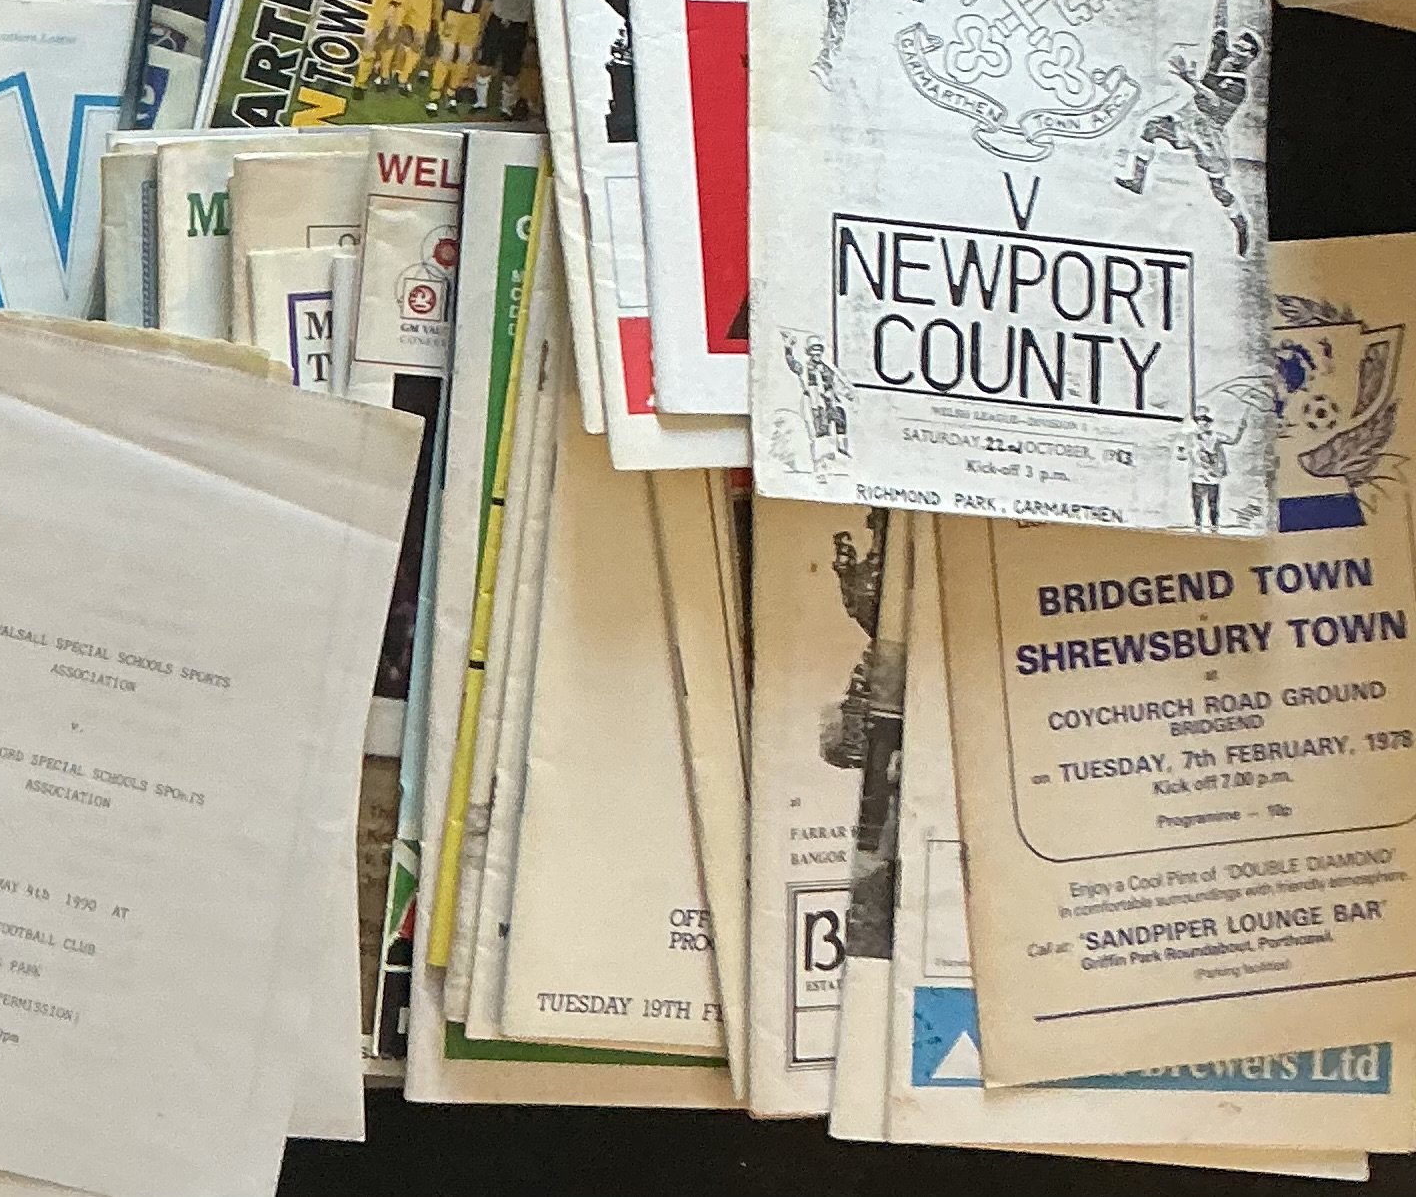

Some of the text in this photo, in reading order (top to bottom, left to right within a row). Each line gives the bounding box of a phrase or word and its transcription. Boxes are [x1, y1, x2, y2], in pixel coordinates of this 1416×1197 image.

[1001, 170, 1041, 232] V
[838, 226, 1190, 332] NEWPORT
[873, 313, 1163, 411] COUNTY
[855, 482, 1125, 524] RICHMOND CARMARTHEN
[1037, 556, 1375, 617] BRIDGEND TOWN
[1016, 608, 1409, 677] SHREWSBURY TOWN
[50, 663, 137, 693] ASSOCIATION
[55, 637, 110, 661] SPECIAL
[117, 651, 174, 675] SCHOOLS
[180, 666, 232, 690] SPORTS
[1047, 679, 1388, 732] COYCHURCH ROAD GROUND
[1169, 713, 1266, 738] BRIDGEND
[30, 754, 85, 777] SPECIAL
[92, 767, 149, 792] SCHOOLS
[1057, 753, 1173, 785] TUESDAY,
[1182, 749, 1218, 771] 7th
[1365, 728, 1415, 754] 1978
[25, 778, 112, 809] ASSOCIATION
[1151, 779, 1190, 798] Kick
[1156, 807, 1242, 830] Programme
[790, 849, 848, 867] BANGOR
[1069, 873, 1162, 901] Enjoy Cool
[65, 893, 98, 913] 1990
[111, 904, 130, 922] AT
[1226, 905, 1324, 934] LOUNGE
[536, 991, 692, 1021] TUESDAY 19TH
[1310, 1045, 1381, 1083] Ltd
